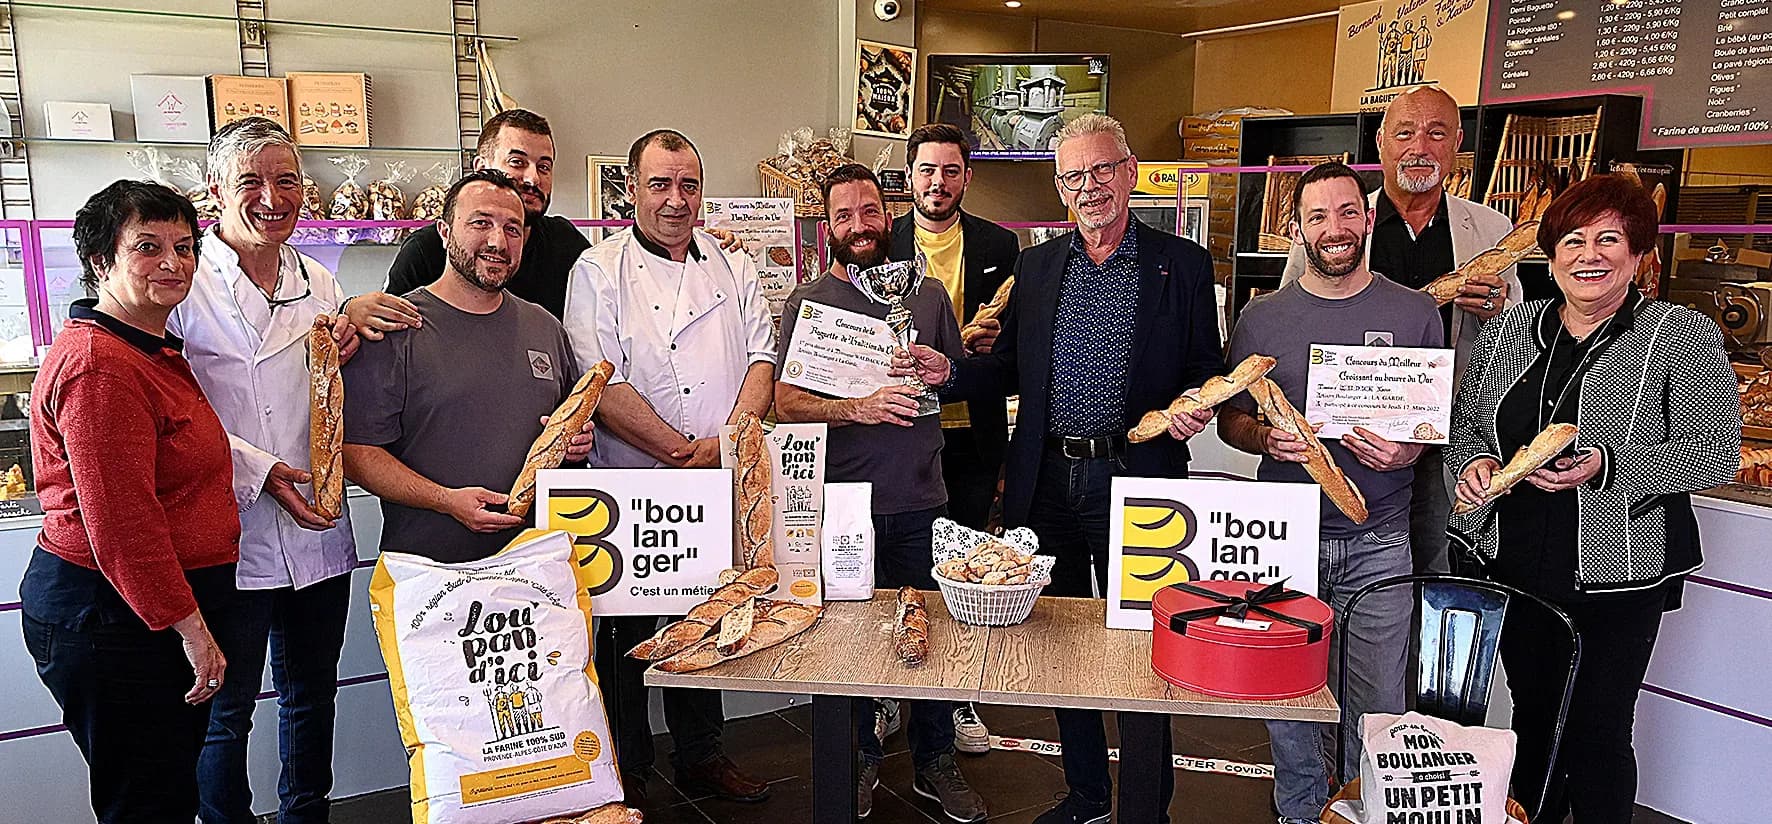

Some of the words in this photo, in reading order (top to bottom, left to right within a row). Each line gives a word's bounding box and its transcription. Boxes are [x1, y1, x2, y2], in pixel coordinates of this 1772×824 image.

[1526, 2, 1554, 12] Baguette
[1719, 11, 1737, 20] Petit
[1737, 7, 1769, 17] complet
[1508, 16, 1531, 25] Pointue
[1599, 16, 1613, 24] 1,30
[1613, 14, 1620, 22] €
[1624, 12, 1642, 21] 220g
[1647, 9, 1663, 18] 5,90
[1663, 6, 1681, 15] €/Kg
[1612, 25, 1618, 33] €
[1622, 24, 1640, 33] 220g
[1645, 21, 1661, 30] 5,90
[1662, 18, 1680, 27] €/Kg
[1506, 37, 1533, 47] Baguette
[1611, 37, 1617, 45] €
[1621, 35, 1639, 44] 400g
[1644, 32, 1660, 41] 4,00
[1661, 31, 1678, 40] €/Kg
[1715, 37, 1726, 45] Le
[1727, 34, 1747, 44] bébé
[1748, 33, 1761, 42] (au
[1504, 48, 1534, 58] Couronne
[1609, 49, 1616, 57] €
[1619, 47, 1638, 56] 220g
[1642, 44, 1659, 53] 5,45
[1659, 42, 1677, 51] €/Kg
[1714, 48, 1736, 57] Boule
[1737, 46, 1748, 55] de
[1608, 60, 1614, 68] €
[1618, 59, 1636, 68] 420g
[1657, 54, 1675, 64] €/Kg
[1712, 61, 1723, 70] Le
[1724, 60, 1743, 70] pavé
[1606, 72, 1613, 80] €
[1617, 70, 1635, 79] 420g
[1656, 66, 1674, 76] €/Kg
[1711, 72, 1735, 82] Olives
[1709, 85, 1735, 95] Figues
[1360, 97, 1369, 105] LA
[1706, 109, 1751, 119] Cranberries
[1657, 127, 1686, 136] Farine
[1687, 125, 1700, 135] de
[1701, 123, 1741, 134] tradition
[1743, 121, 1769, 131] 100%
[1345, 356, 1378, 367] Concours
[1379, 357, 1388, 367] du
[1387, 356, 1422, 368] Meilleur
[1339, 371, 1373, 382] Croissant
[1384, 373, 1407, 383] beurre
[1407, 374, 1416, 383] du
[1418, 372, 1434, 385] Var
[781, 463, 816, 480] d'ici
[631, 498, 704, 524] "bou
[1210, 511, 1288, 541] "bou
[633, 524, 679, 549] lan
[1211, 538, 1260, 565] lan
[632, 547, 698, 579] ger"
[630, 586, 661, 596] C'est
[663, 588, 679, 596] un
[458, 600, 535, 637] Lou
[462, 627, 537, 669] pan
[469, 650, 544, 687] d'ici
[482, 747, 494, 756] LA
[494, 741, 524, 754] FARINE
[526, 736, 549, 747] 100%
[549, 731, 566, 742] SUD
[547, 741, 568, 752] D'AZUR
[1403, 734, 1442, 750] MON
[1376, 751, 1478, 769] BOULANGER
[1424, 773, 1446, 781] choisi
[1384, 787, 1417, 808] UN
[1421, 782, 1483, 808] PETIT
[1386, 808, 1483, 824] MOULIN
